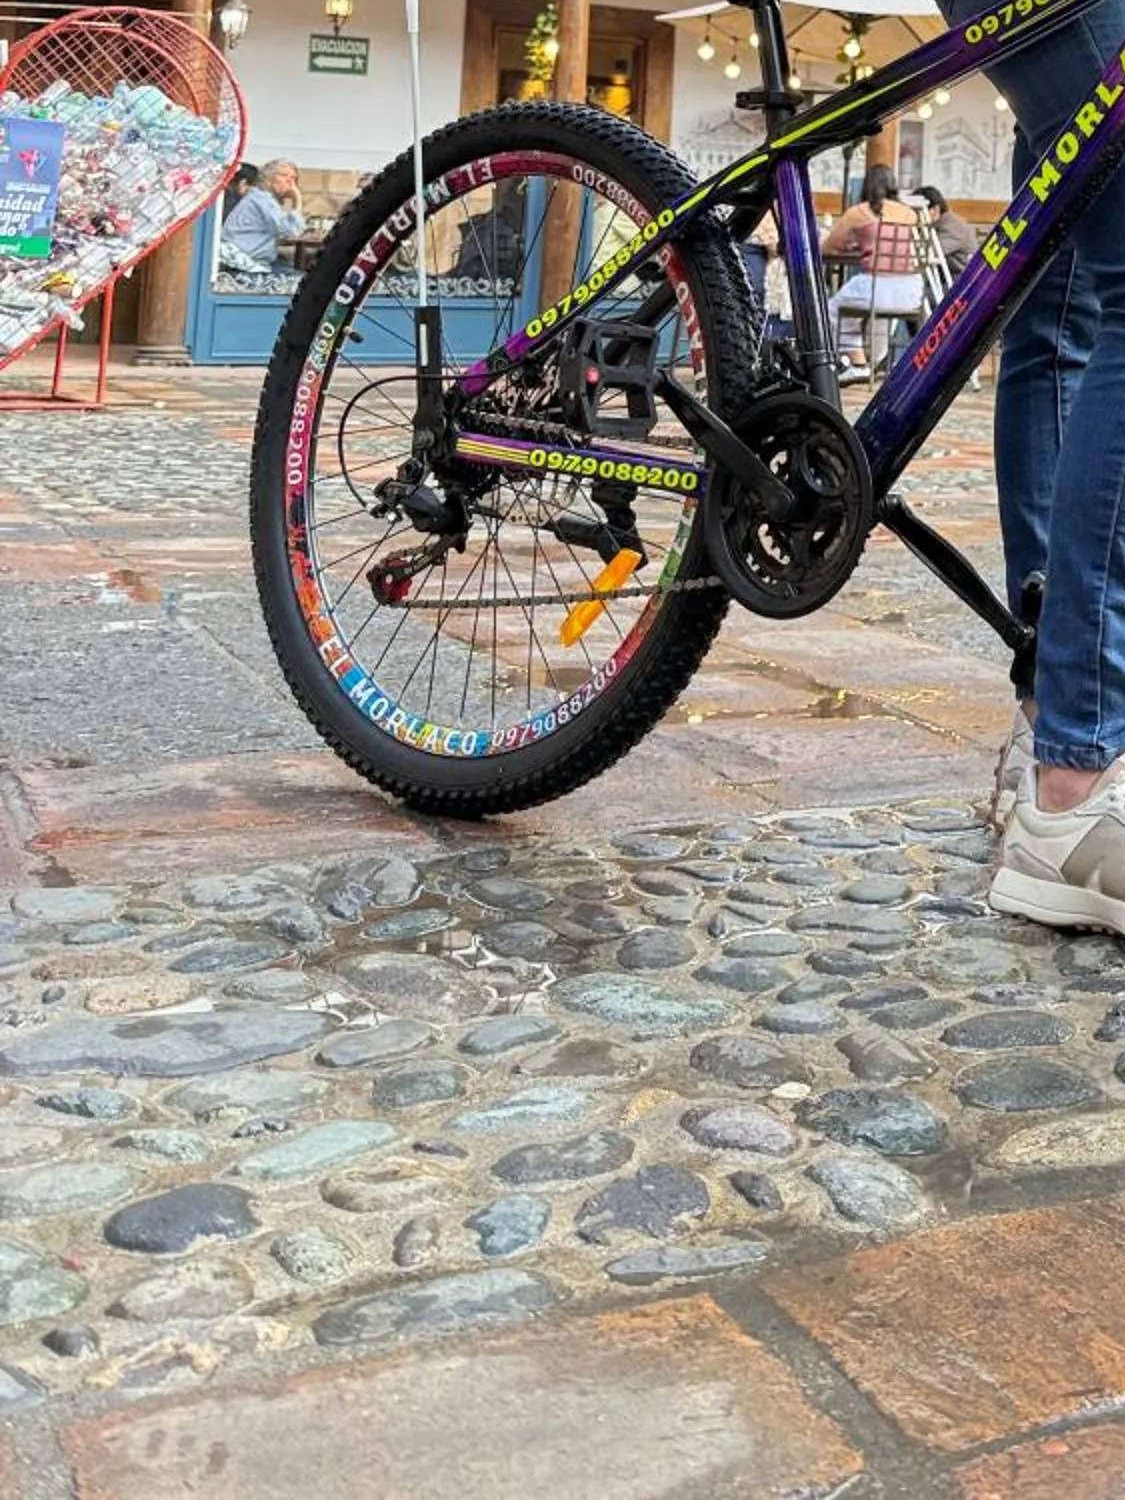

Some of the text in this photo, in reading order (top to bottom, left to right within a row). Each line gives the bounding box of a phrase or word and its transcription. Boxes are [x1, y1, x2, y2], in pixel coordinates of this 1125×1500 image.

[464, 157, 494, 185] EL
[525, 208, 675, 339] 0979088200
[981, 213, 1028, 271] EL
[912, 296, 969, 371] HOTEL
[530, 449, 698, 491] 0979088200
[319, 638, 618, 755] EL MORLACO 0979088200
